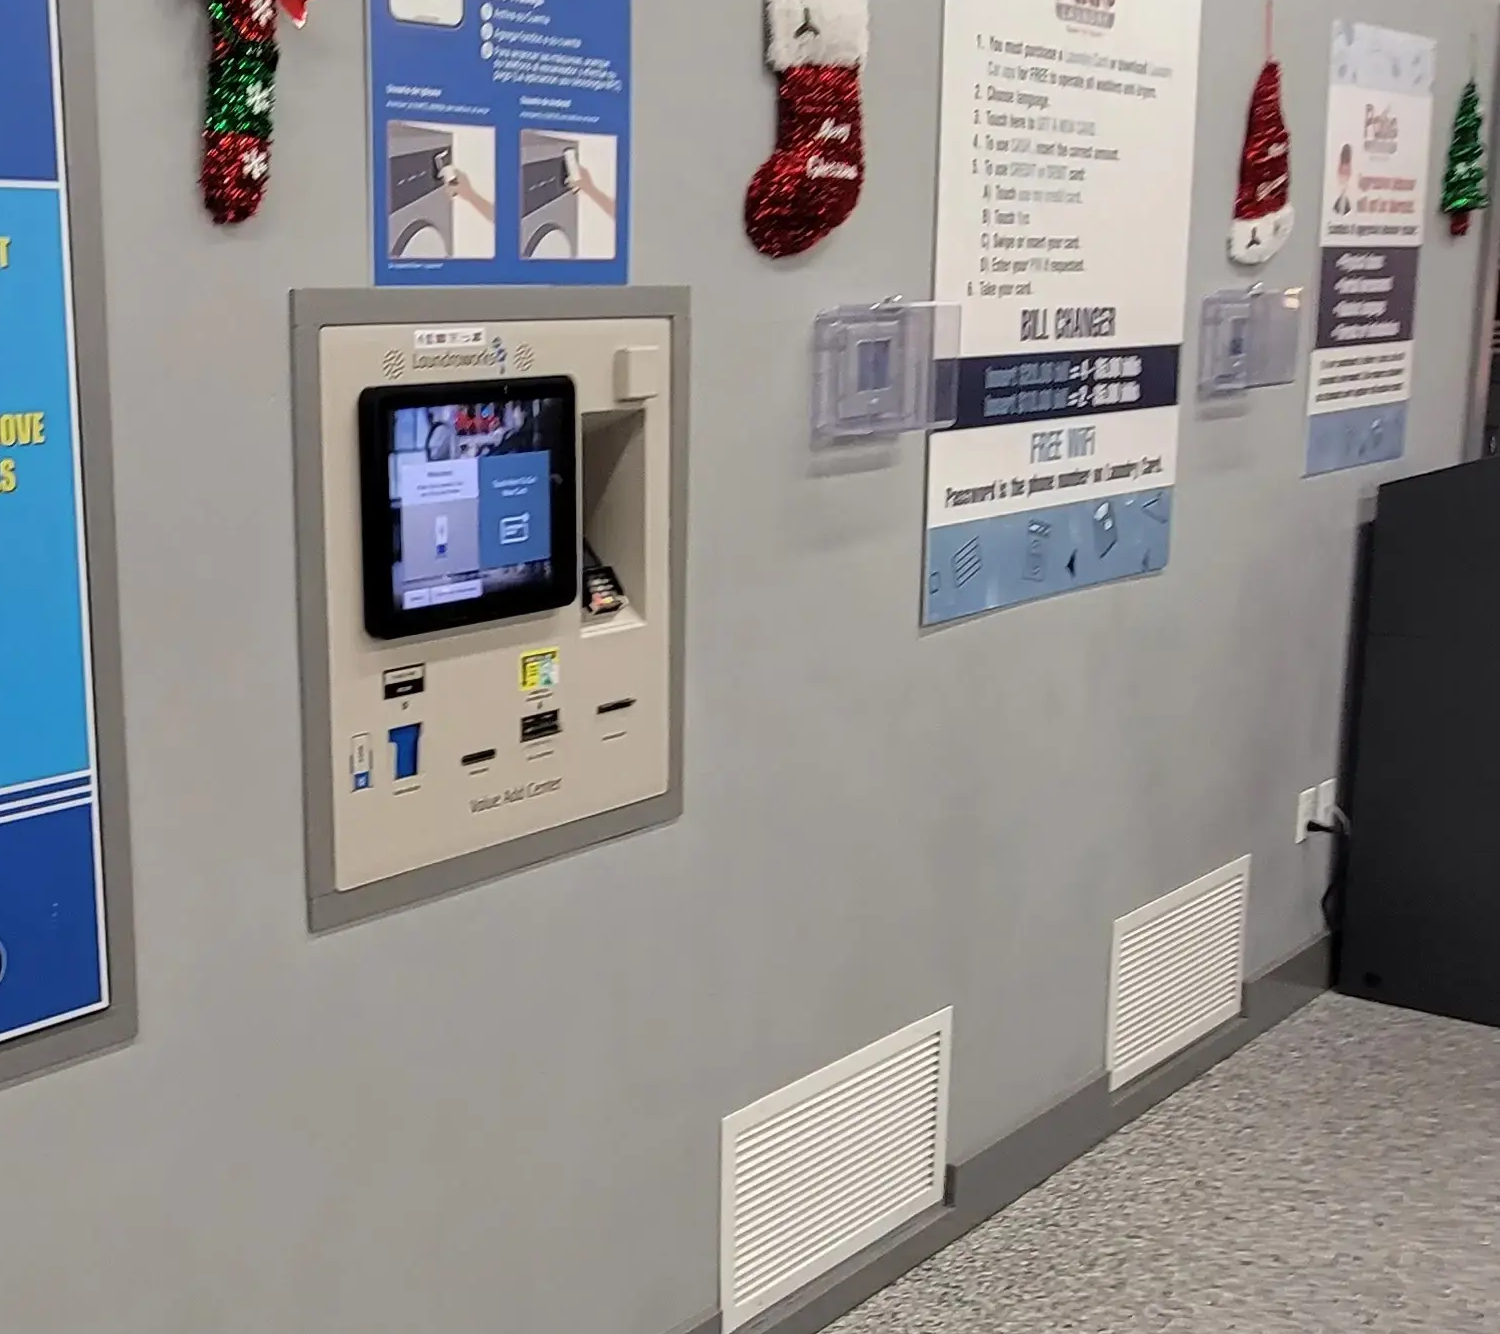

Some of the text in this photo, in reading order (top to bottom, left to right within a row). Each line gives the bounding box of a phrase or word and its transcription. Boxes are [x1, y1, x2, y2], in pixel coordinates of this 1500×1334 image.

[1020, 307, 1116, 341] BILL CHANGER
[1030, 429, 1064, 463] FREE
